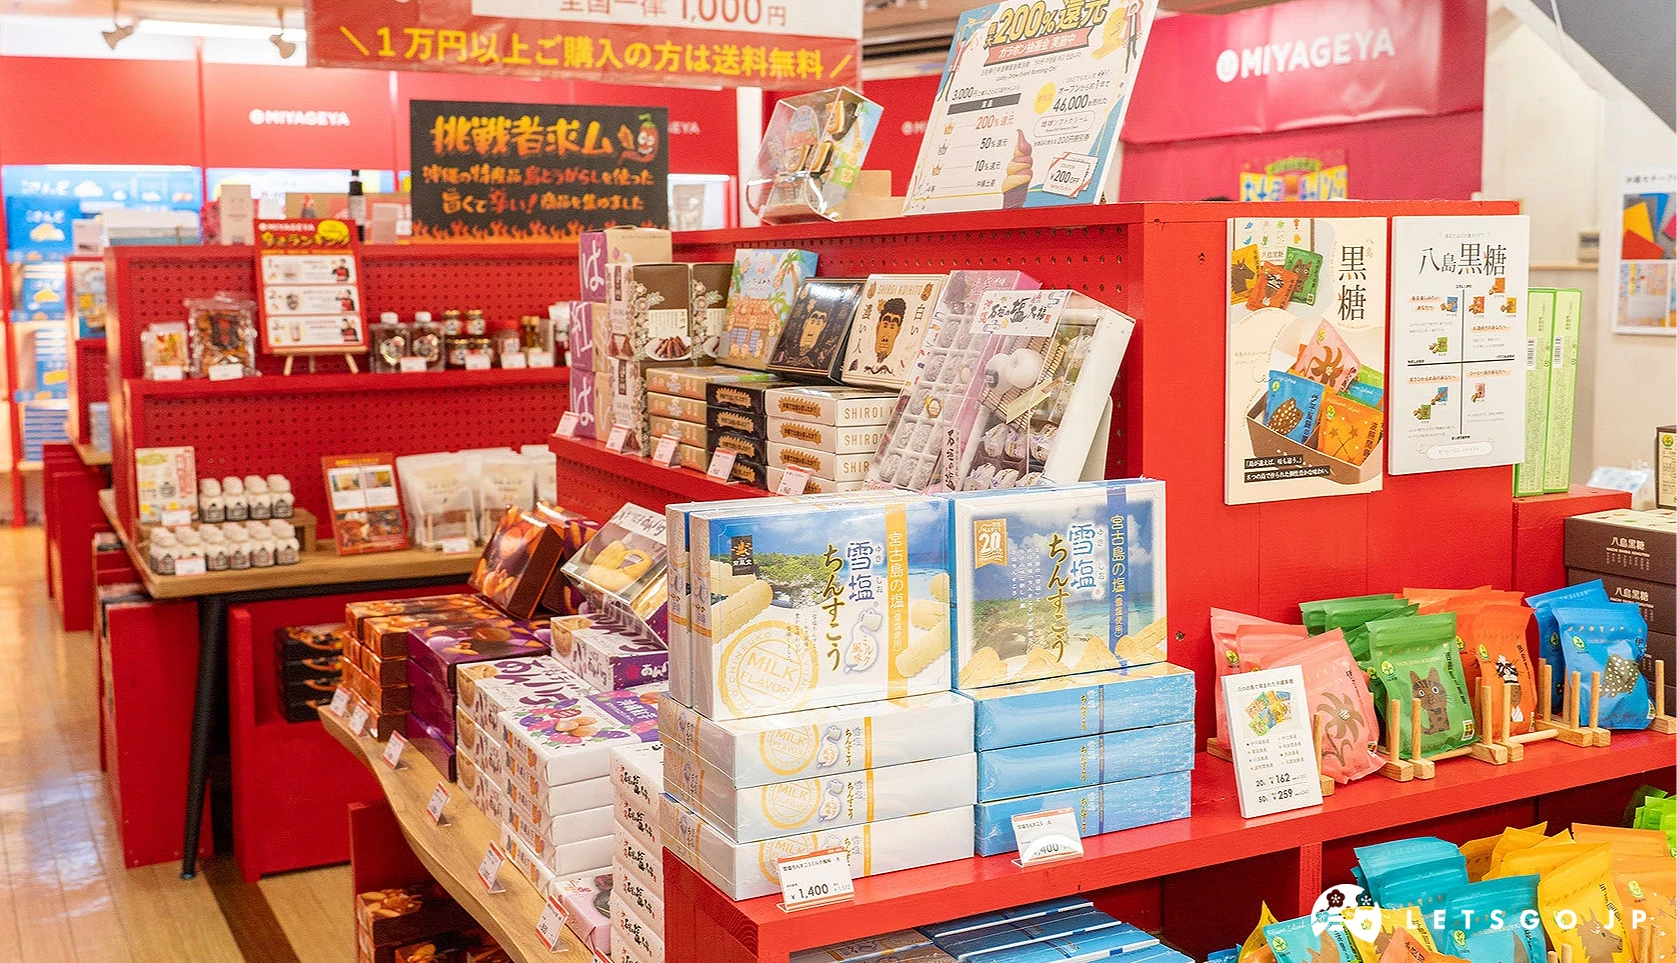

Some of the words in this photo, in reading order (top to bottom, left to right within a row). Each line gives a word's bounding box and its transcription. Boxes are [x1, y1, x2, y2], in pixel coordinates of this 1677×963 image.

[1240, 26, 1396, 79] MIYAGEYA
[265, 109, 350, 126] MIYAGEYA
[430, 115, 614, 158] 挑戦者求ム
[1417, 243, 1508, 277] 八島黒糖
[1337, 245, 1367, 321] 黒糖
[844, 406, 884, 420] SHIROI
[978, 531, 1002, 554] 20
[1610, 536, 1645, 551] 八島黒糖
[1068, 523, 1098, 590] 雪塩
[846, 540, 875, 602] 雪塩
[821, 543, 846, 672] ちんすこう
[1047, 532, 1070, 664] ちんすこう
[1614, 586, 1650, 602] 八島黒糖
[747, 652, 799, 683] MILK
[740, 670, 791, 697] FLAVOR
[776, 729, 807, 747] MILK
[1275, 773, 1291, 784] 162
[777, 784, 809, 801] MILK
[1277, 788, 1293, 800] 259
